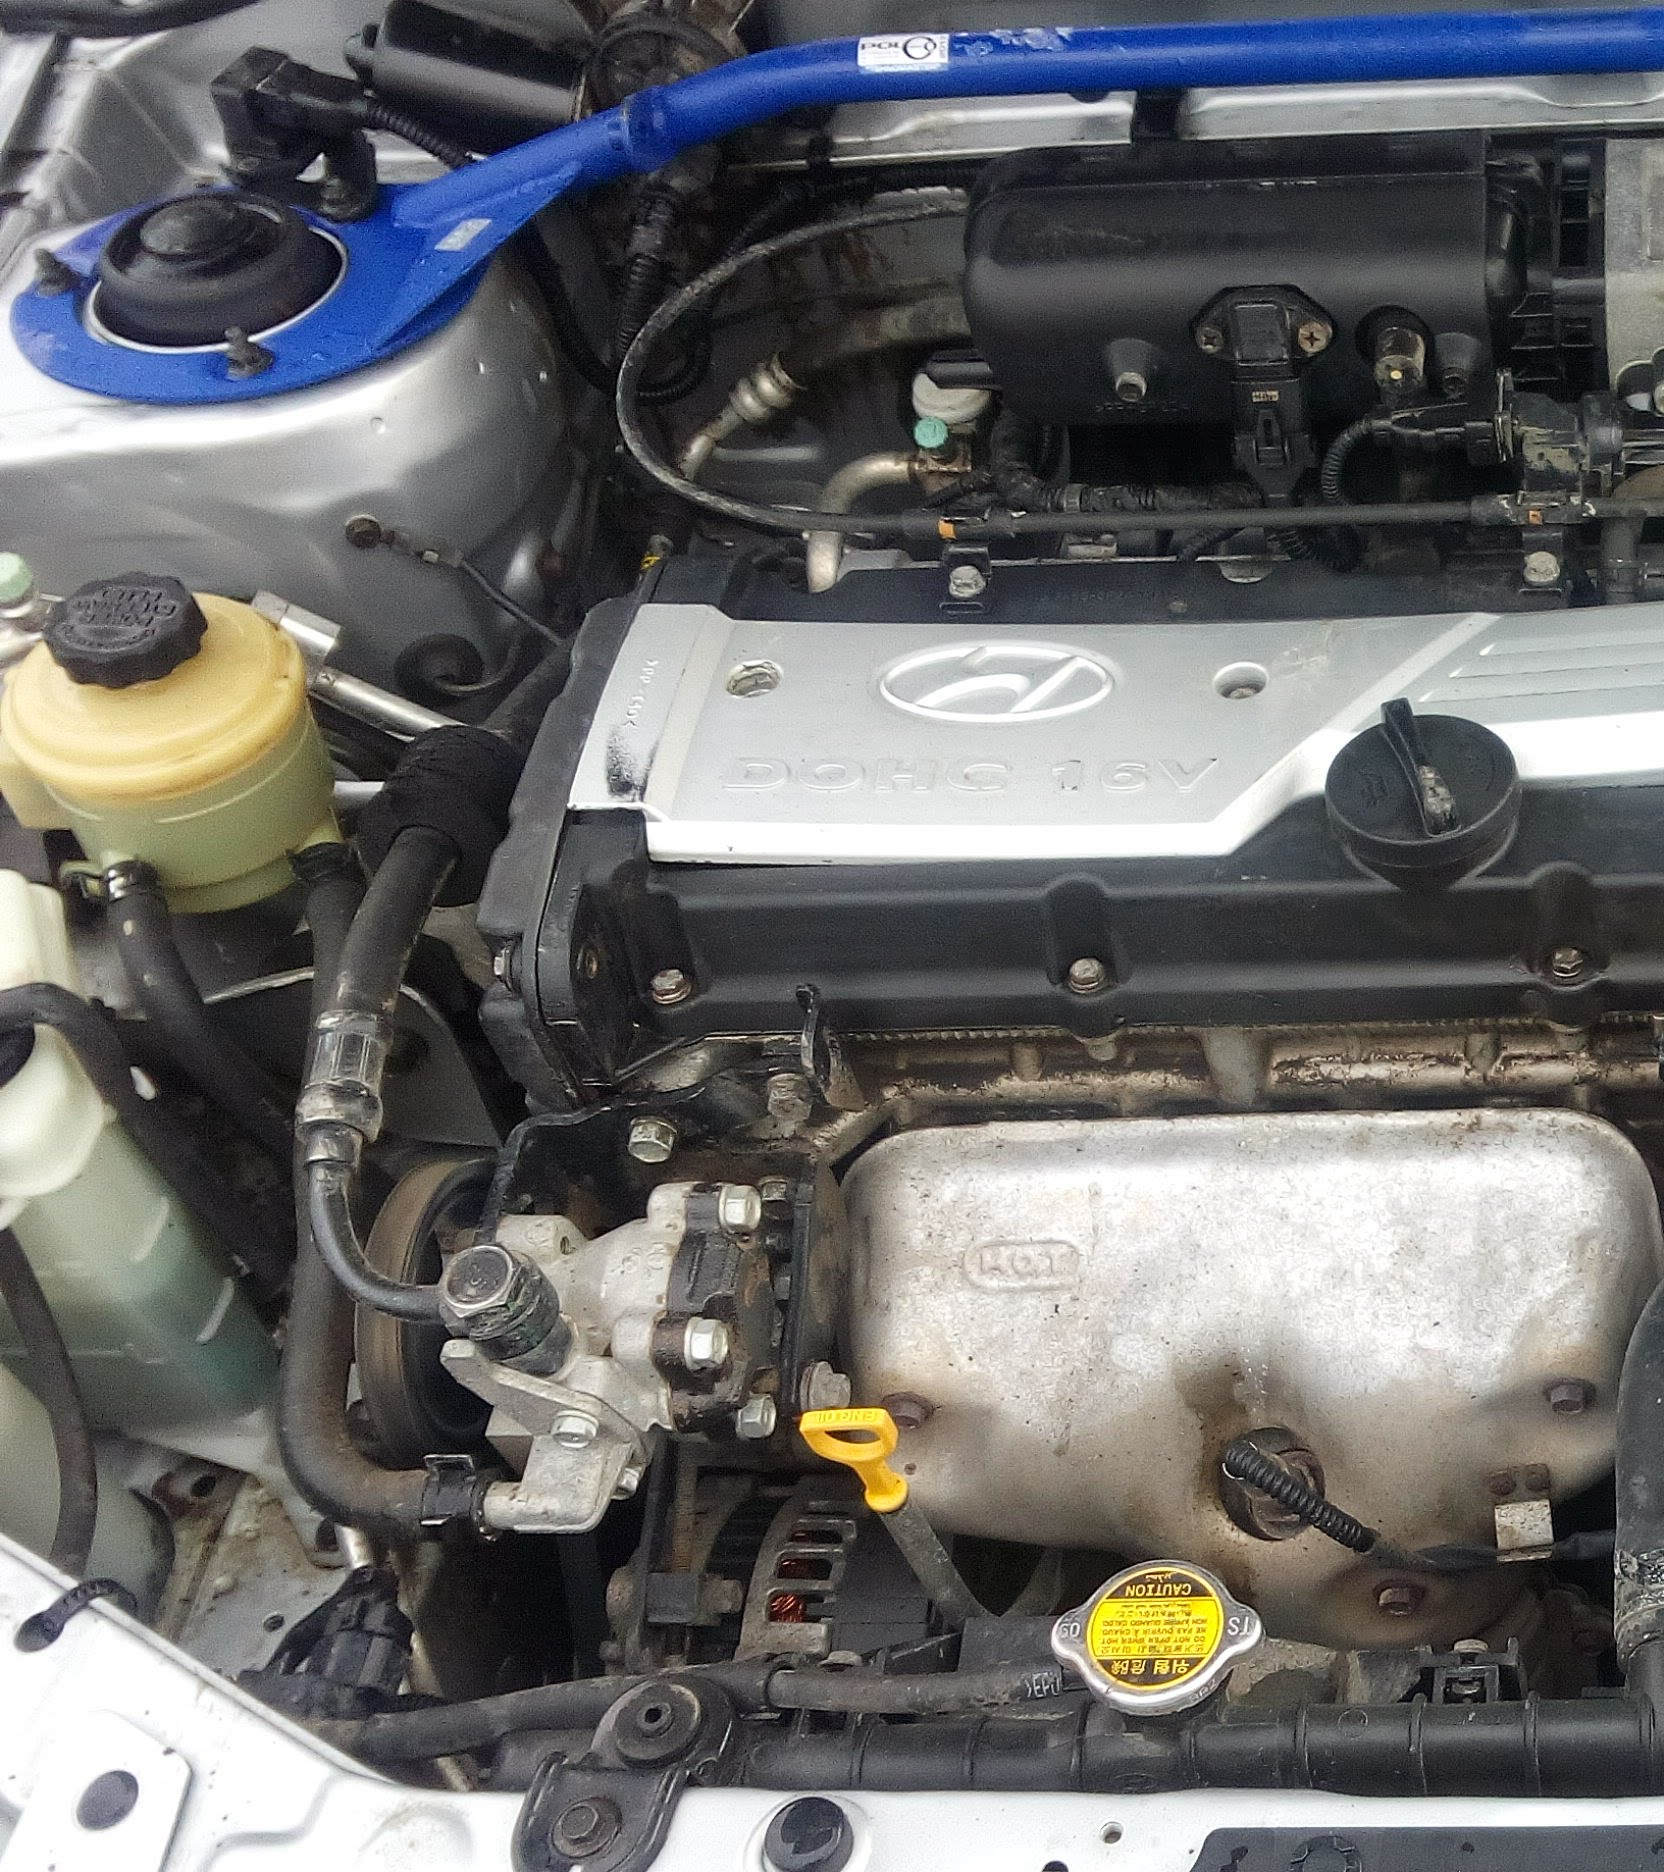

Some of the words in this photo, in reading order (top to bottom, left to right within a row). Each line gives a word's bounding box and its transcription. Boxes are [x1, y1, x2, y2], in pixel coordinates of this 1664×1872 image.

[722, 757, 1013, 793] DOHC
[1050, 757, 1218, 793] 16V
[1125, 1583, 1192, 1597] CAUTION
[1227, 1616, 1250, 1636] TS
[1173, 1636, 1191, 1644] NOT
[1153, 1658, 1190, 1675] 위험
